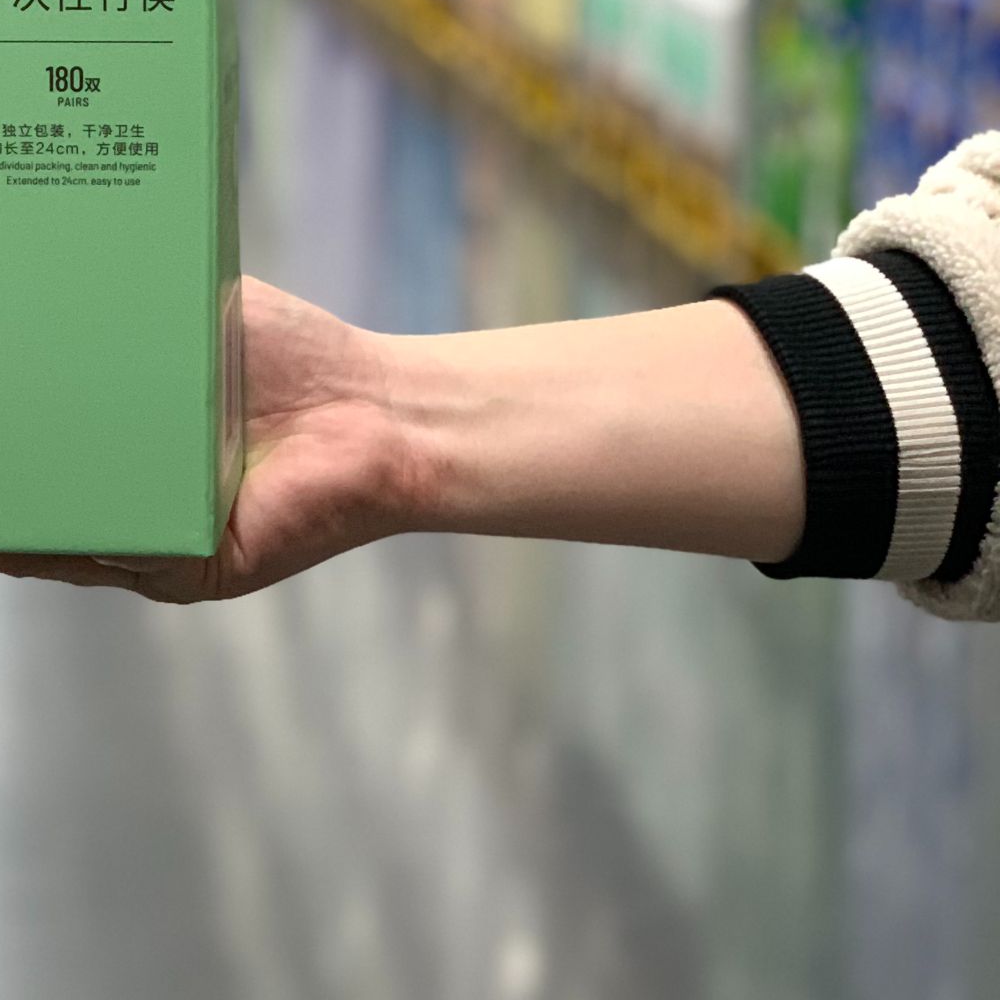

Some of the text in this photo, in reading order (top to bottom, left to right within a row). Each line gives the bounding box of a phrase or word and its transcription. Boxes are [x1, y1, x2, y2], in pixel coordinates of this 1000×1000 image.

[45, 65, 101, 93] 180双
[57, 96, 89, 107] PAIRS
[75, 161, 99, 171] clean
[100, 161, 118, 171] and
[119, 161, 157, 173] hygienic
[6, 176, 50, 186] Extended
[51, 177, 60, 186] to
[90, 178, 112, 188] easy
[113, 177, 123, 186] to
[124, 178, 141, 186] use
